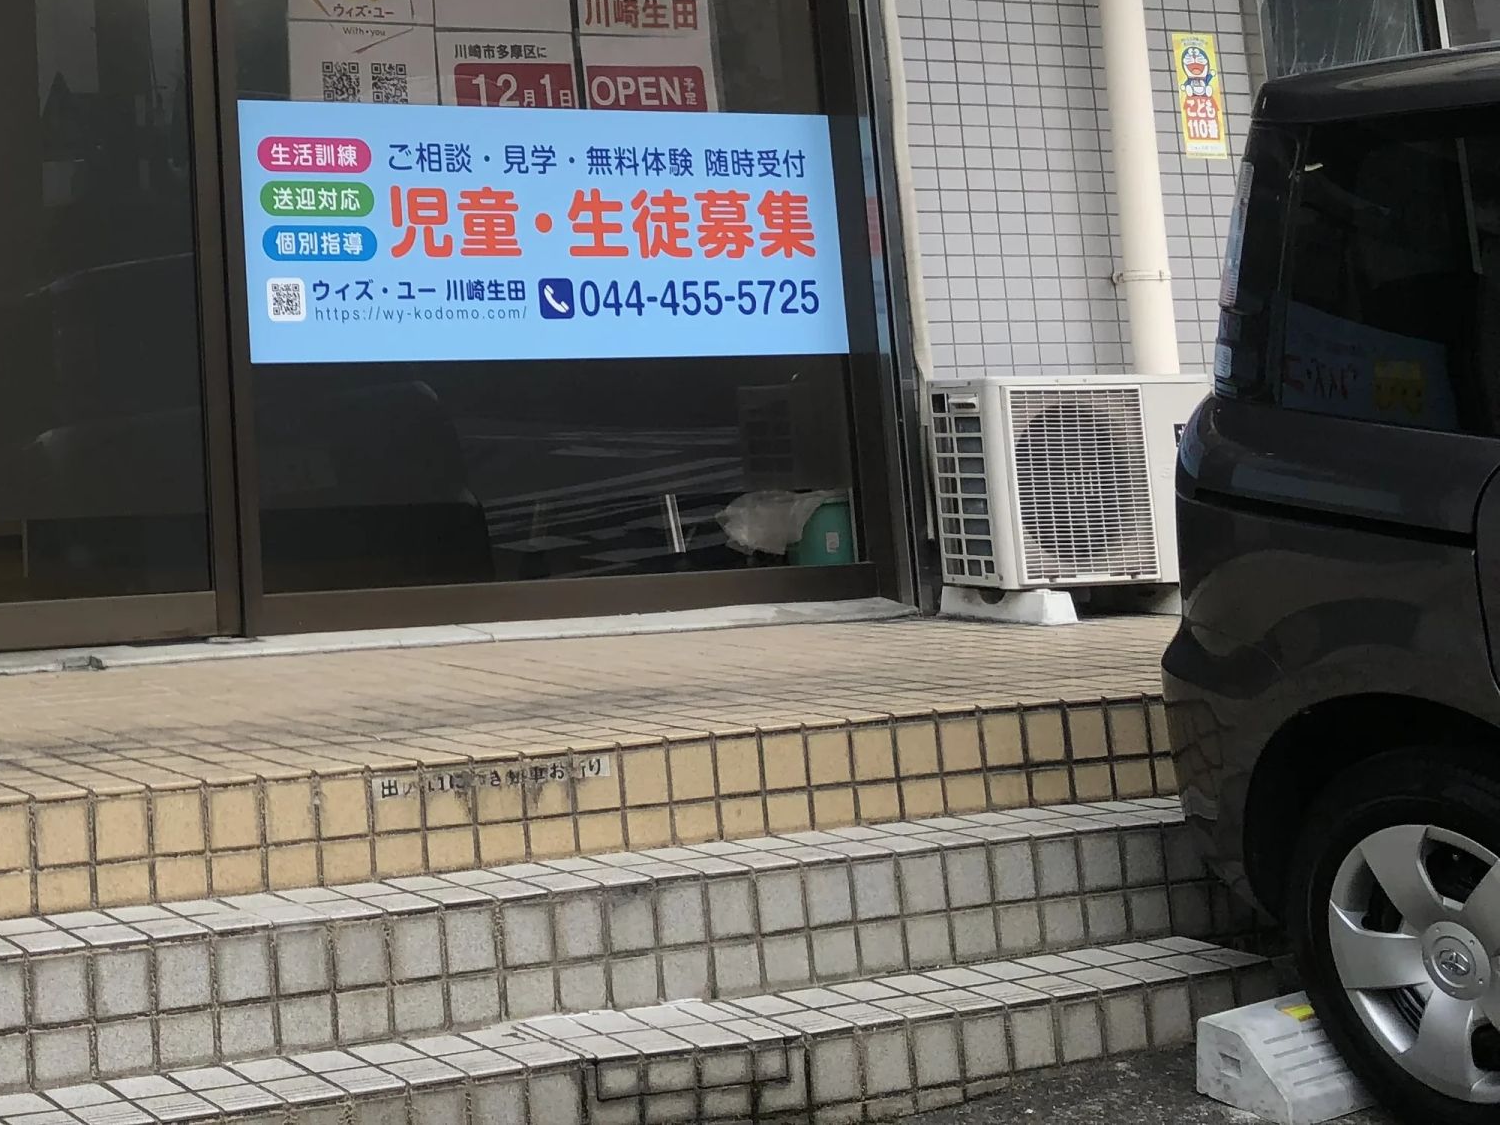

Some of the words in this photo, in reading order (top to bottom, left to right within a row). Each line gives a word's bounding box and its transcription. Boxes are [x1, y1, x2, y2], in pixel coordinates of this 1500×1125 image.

[333, 3, 395, 19] ウィズ・ユー
[454, 44, 548, 60] 川崎市多摩区に
[472, 73, 574, 108] 12月1日
[1186, 98, 1216, 119] こども
[270, 143, 358, 167] 生活訓練
[705, 148, 806, 178] 随時受付
[272, 187, 361, 211] 送迎対応
[390, 186, 816, 259] 児童・生徒募集
[275, 231, 363, 256] 個別指導
[312, 279, 437, 301] ウィズ・ユー
[446, 279, 526, 302] 川崎生田
[580, 279, 820, 317] 044-455-5725
[315, 305, 527, 323] https://wy-kodomo.com/
